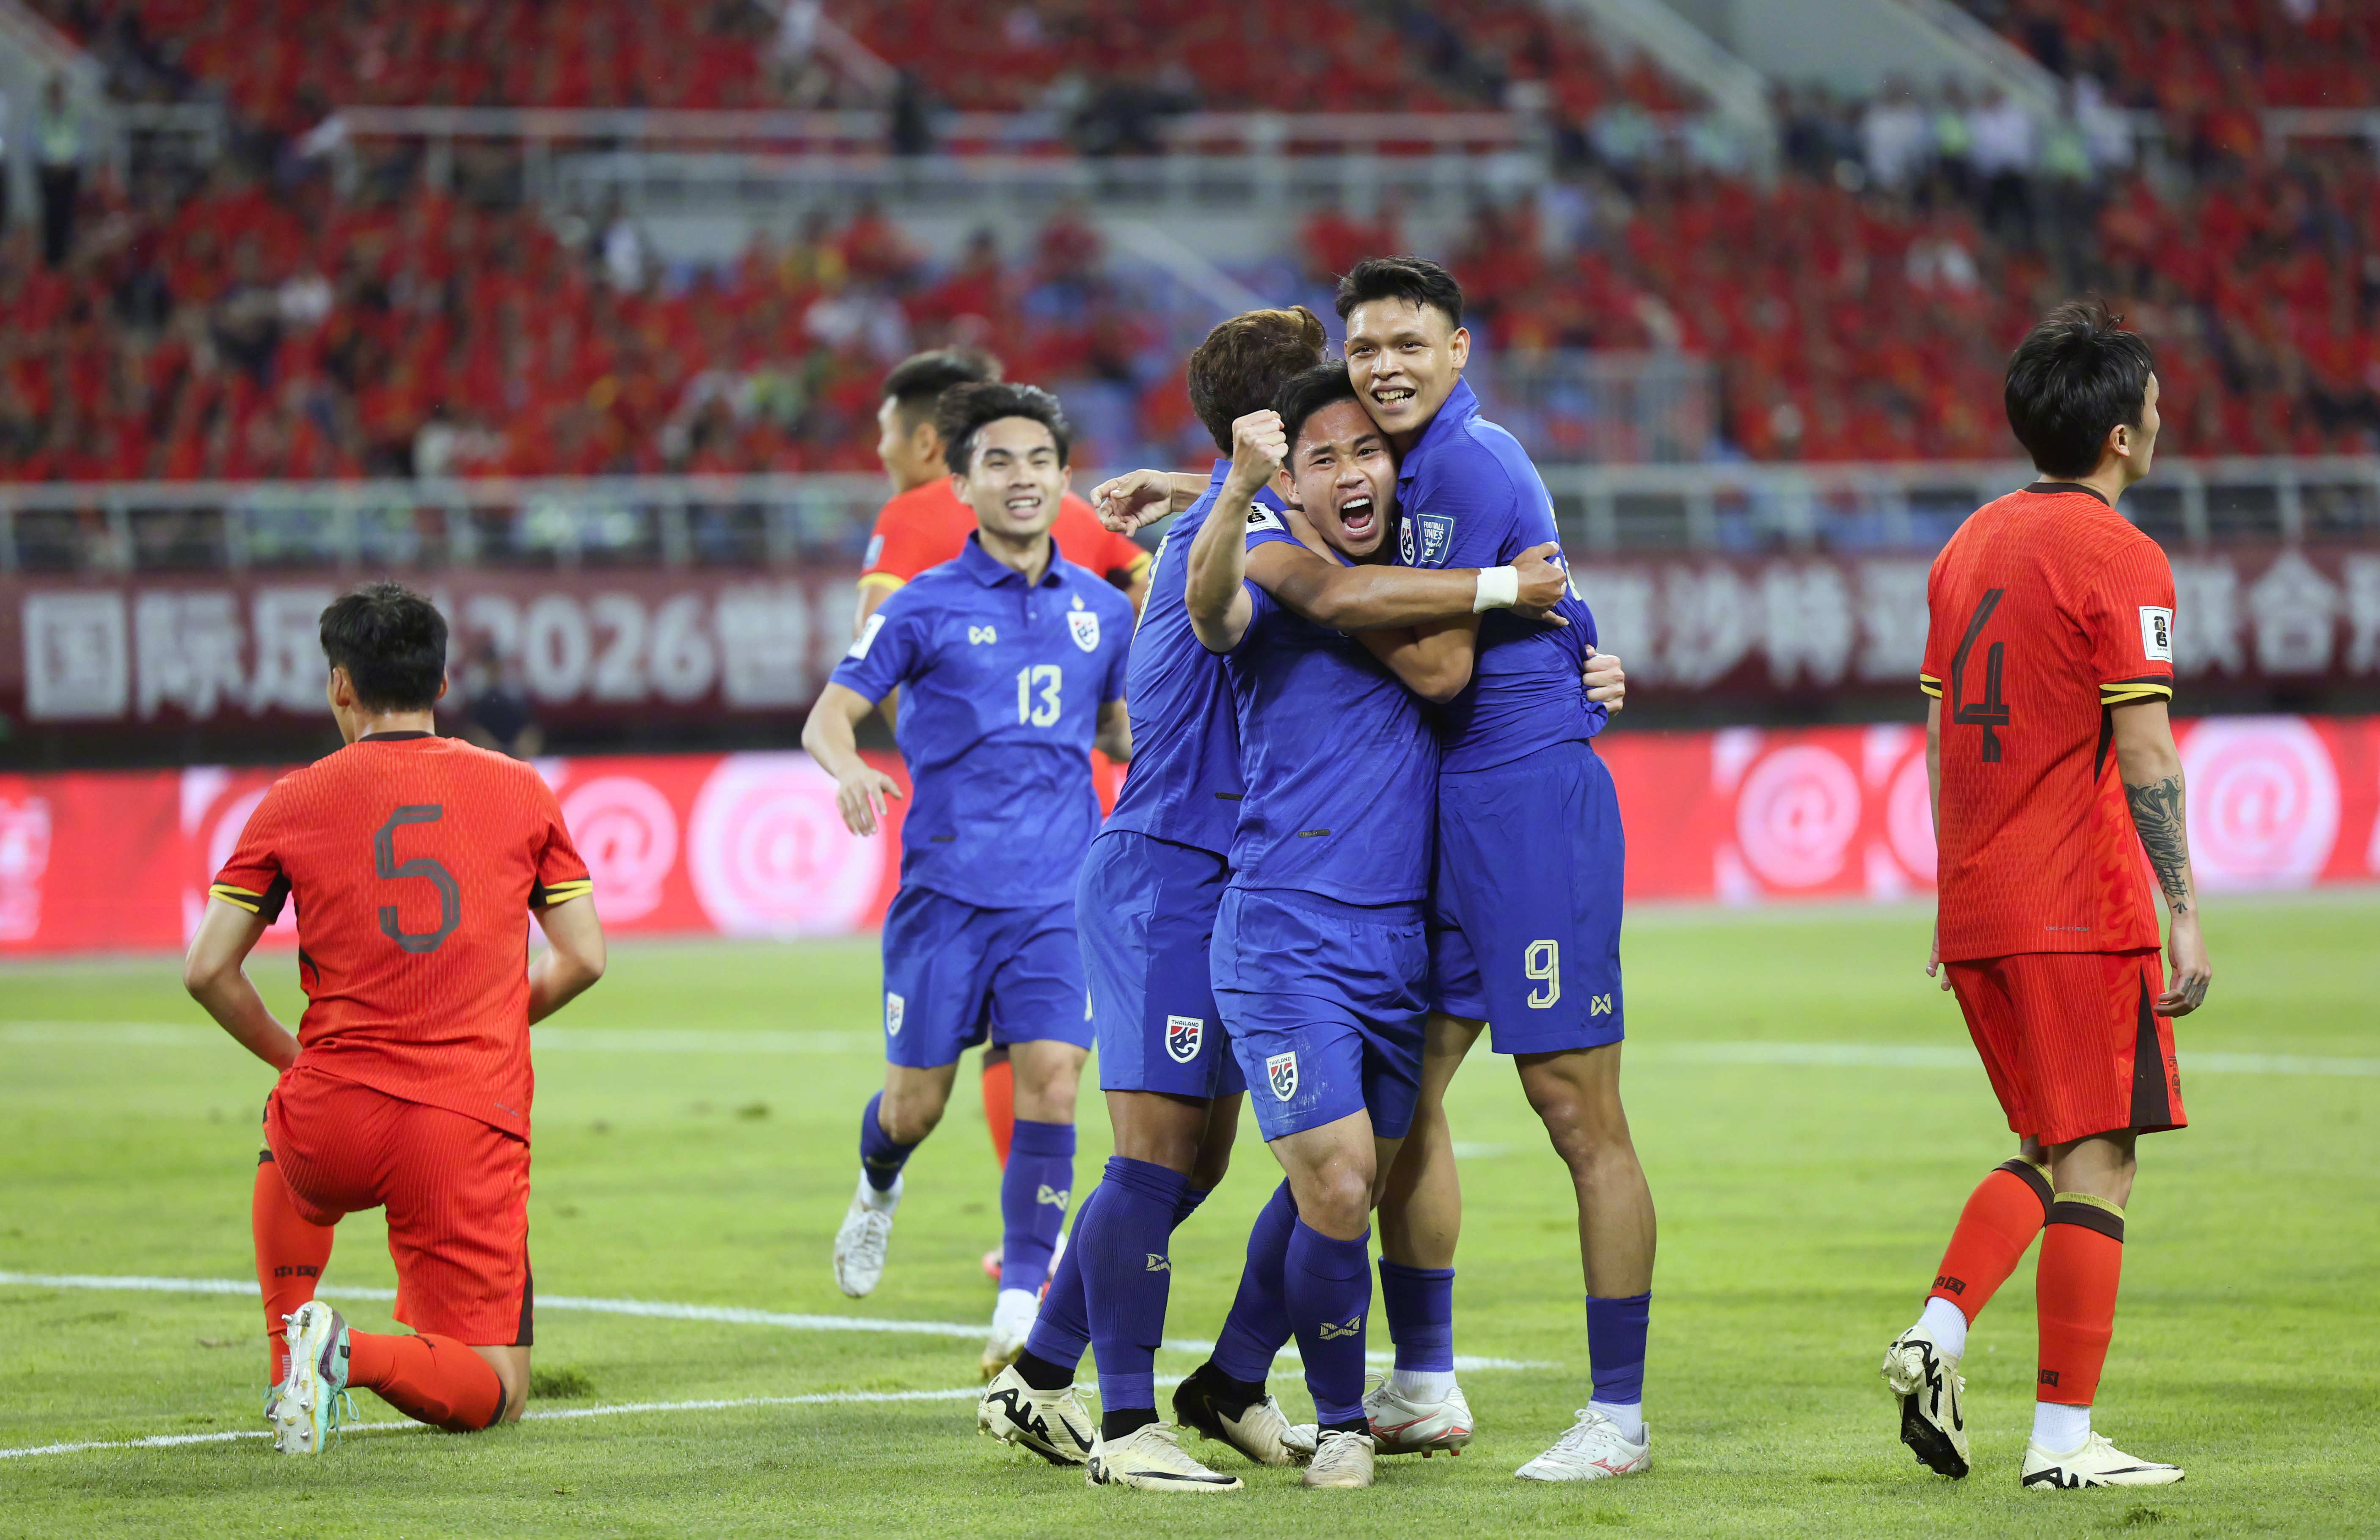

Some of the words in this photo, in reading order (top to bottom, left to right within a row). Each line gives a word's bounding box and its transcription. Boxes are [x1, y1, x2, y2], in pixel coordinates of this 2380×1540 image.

[1017, 665, 1062, 728] 13
[1951, 588, 2009, 763] 4
[373, 804, 460, 953] 5
[1525, 939, 1560, 1009] 9
[1269, 1056, 1292, 1066] THAILAND
[2037, 1369, 2059, 1387] 国
